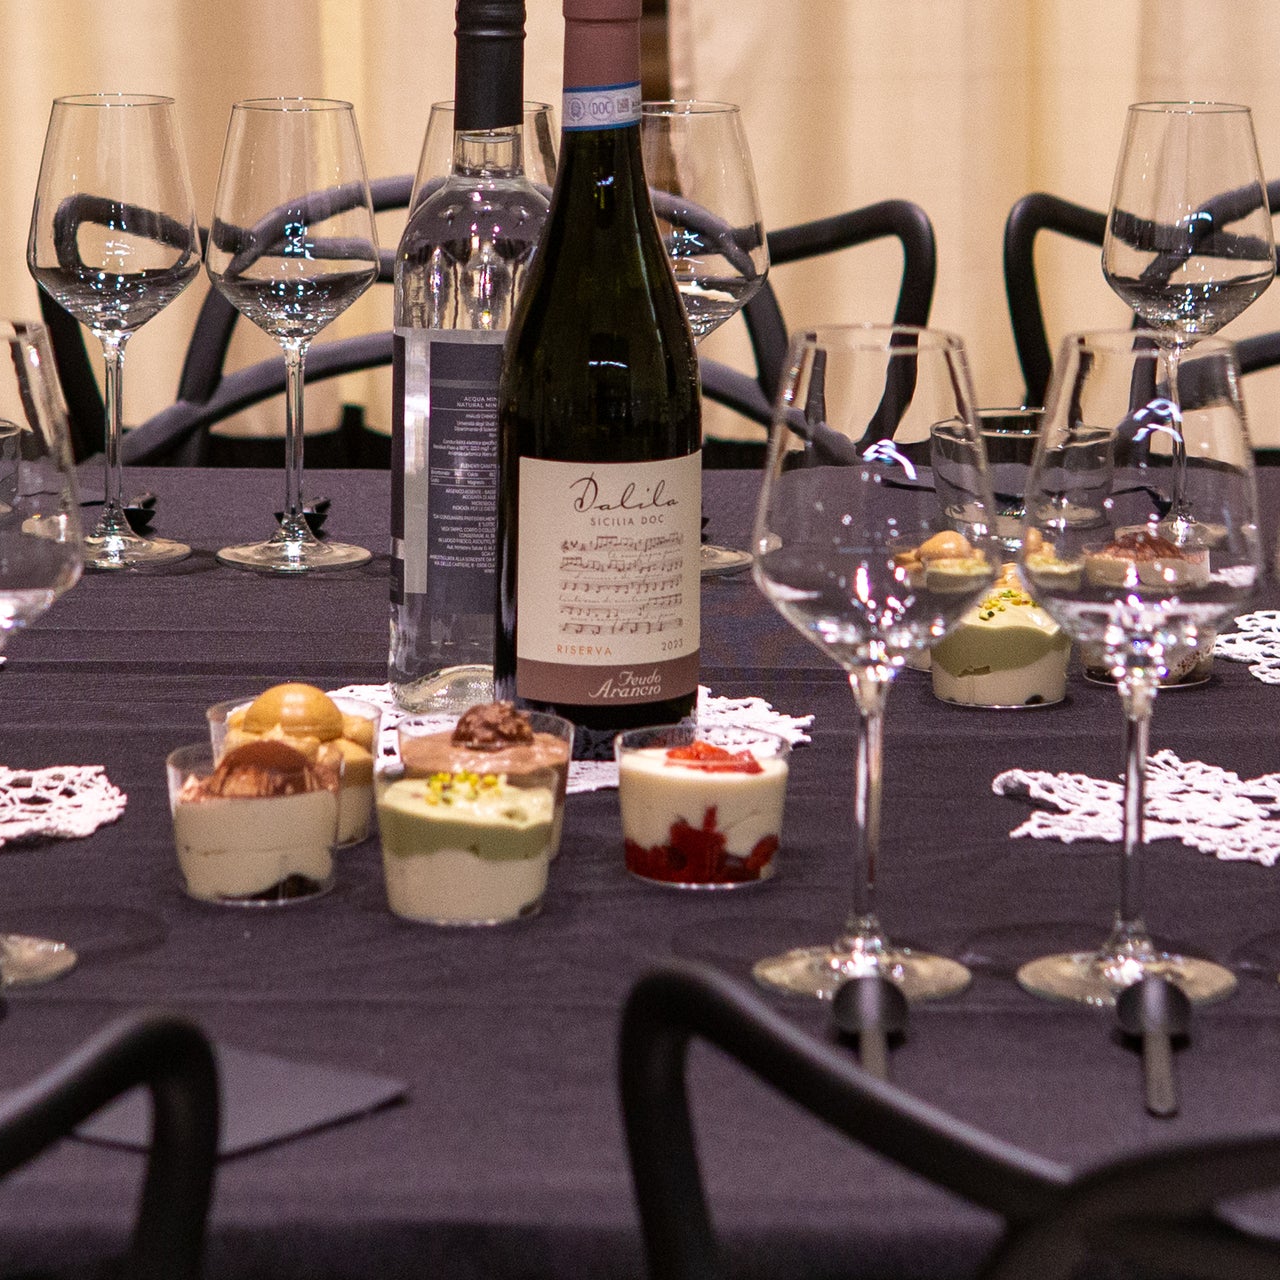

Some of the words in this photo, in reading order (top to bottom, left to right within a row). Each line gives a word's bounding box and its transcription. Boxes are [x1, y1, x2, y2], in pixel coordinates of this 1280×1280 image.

[592, 102, 611, 115] DOC
[570, 472, 679, 513] Dalila
[590, 516, 634, 527] SICILIA
[640, 514, 665, 525] DOC
[556, 644, 613, 656] RISERVA
[661, 638, 684, 651] 2023
[618, 668, 662, 687] Feudo
[588, 678, 662, 699] Arancio
